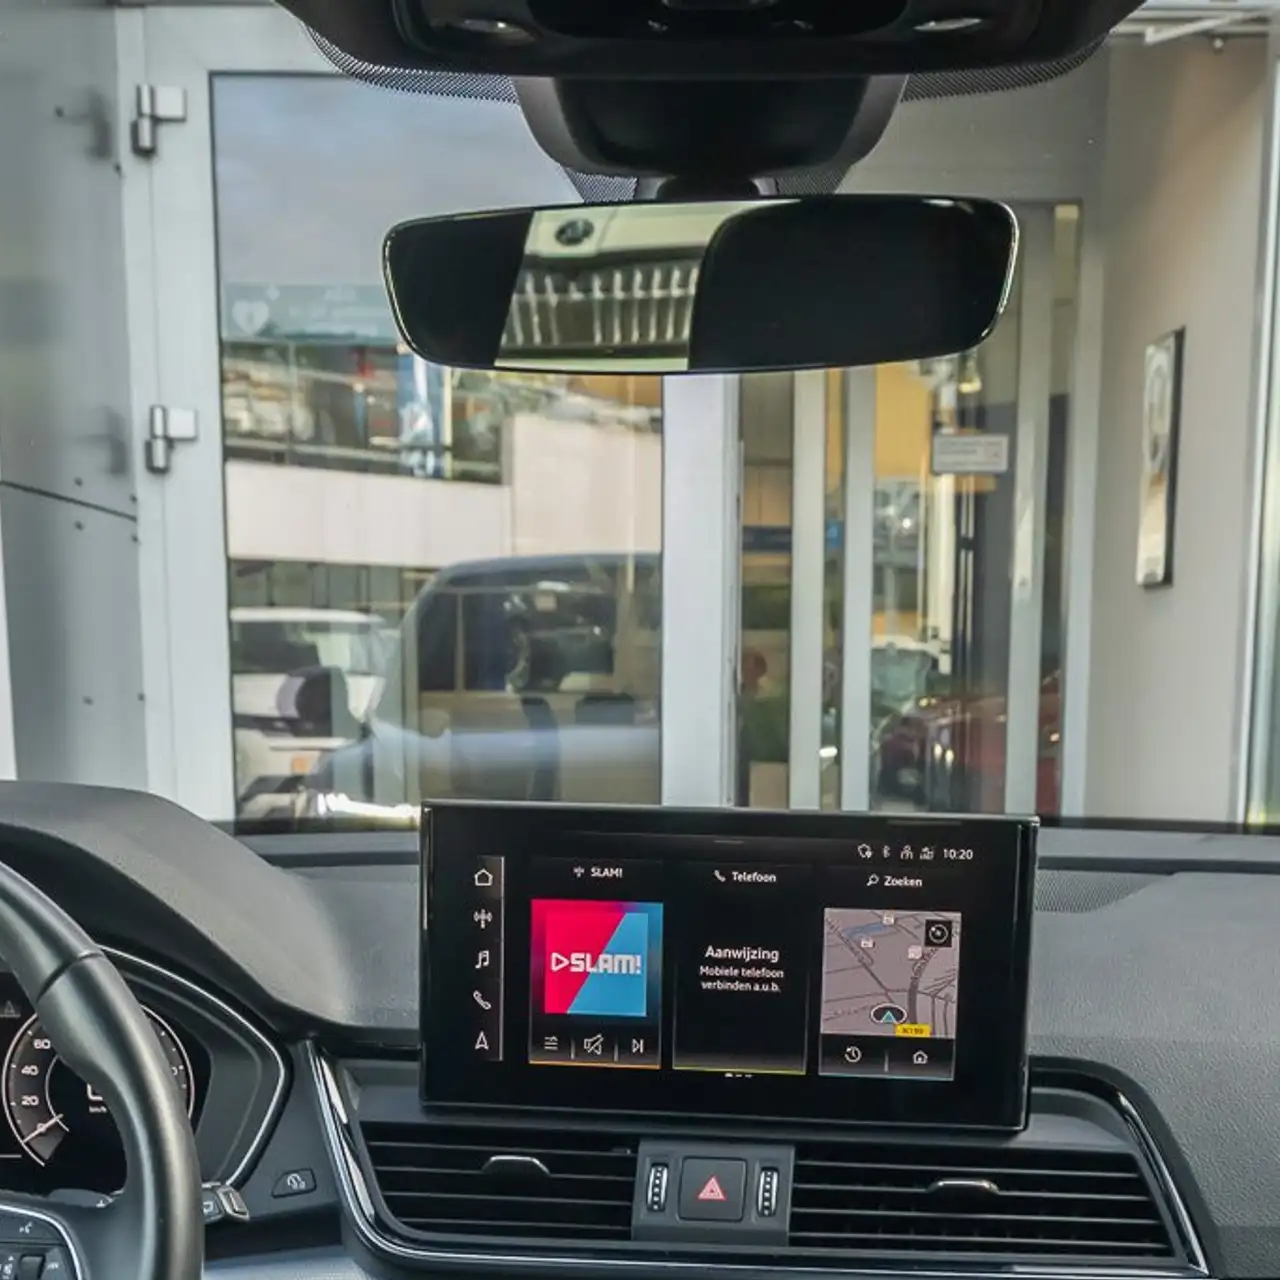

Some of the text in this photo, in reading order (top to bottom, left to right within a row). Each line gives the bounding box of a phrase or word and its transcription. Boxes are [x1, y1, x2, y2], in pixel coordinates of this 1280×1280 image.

[943, 849, 973, 860] 10:20
[590, 867, 623, 878] SLAM!
[732, 871, 777, 883] Telefoon
[884, 876, 923, 888] Zoeken
[704, 945, 780, 963] Aanwijzing
[570, 952, 642, 975] SLAM!
[699, 965, 784, 979] Mobiele telefoon
[701, 979, 782, 993] verbinden a.u.b.
[33, 1039, 51, 1050] 60
[21, 1065, 39, 1076] 40
[21, 1095, 39, 1106] 20
